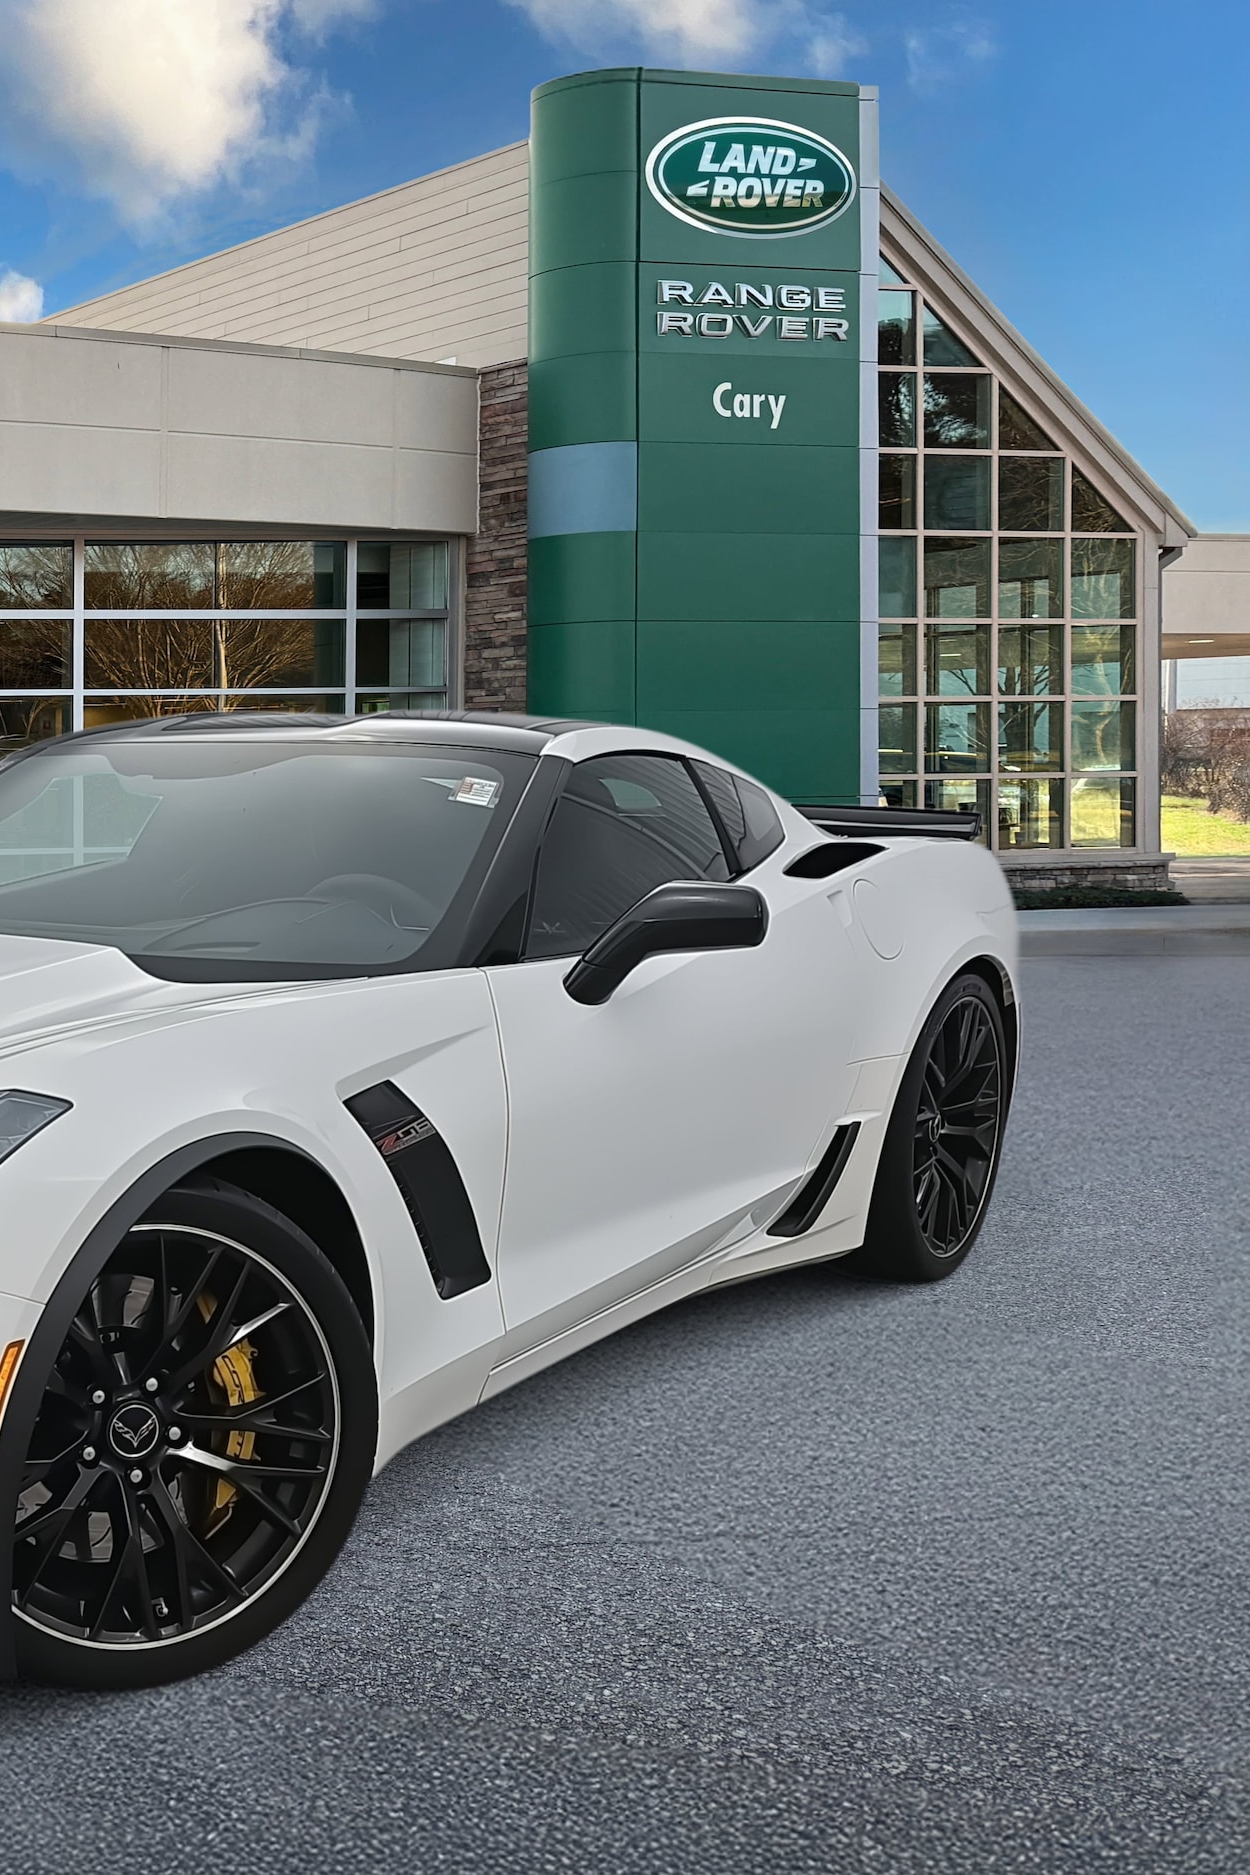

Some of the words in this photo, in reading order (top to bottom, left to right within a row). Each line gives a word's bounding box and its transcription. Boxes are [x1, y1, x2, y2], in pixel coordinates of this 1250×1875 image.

[697, 141, 796, 175] LAND
[709, 176, 825, 208] ROVER
[656, 279, 847, 312] RANGE
[656, 311, 849, 342] ROVER
[712, 381, 786, 429] Cary
